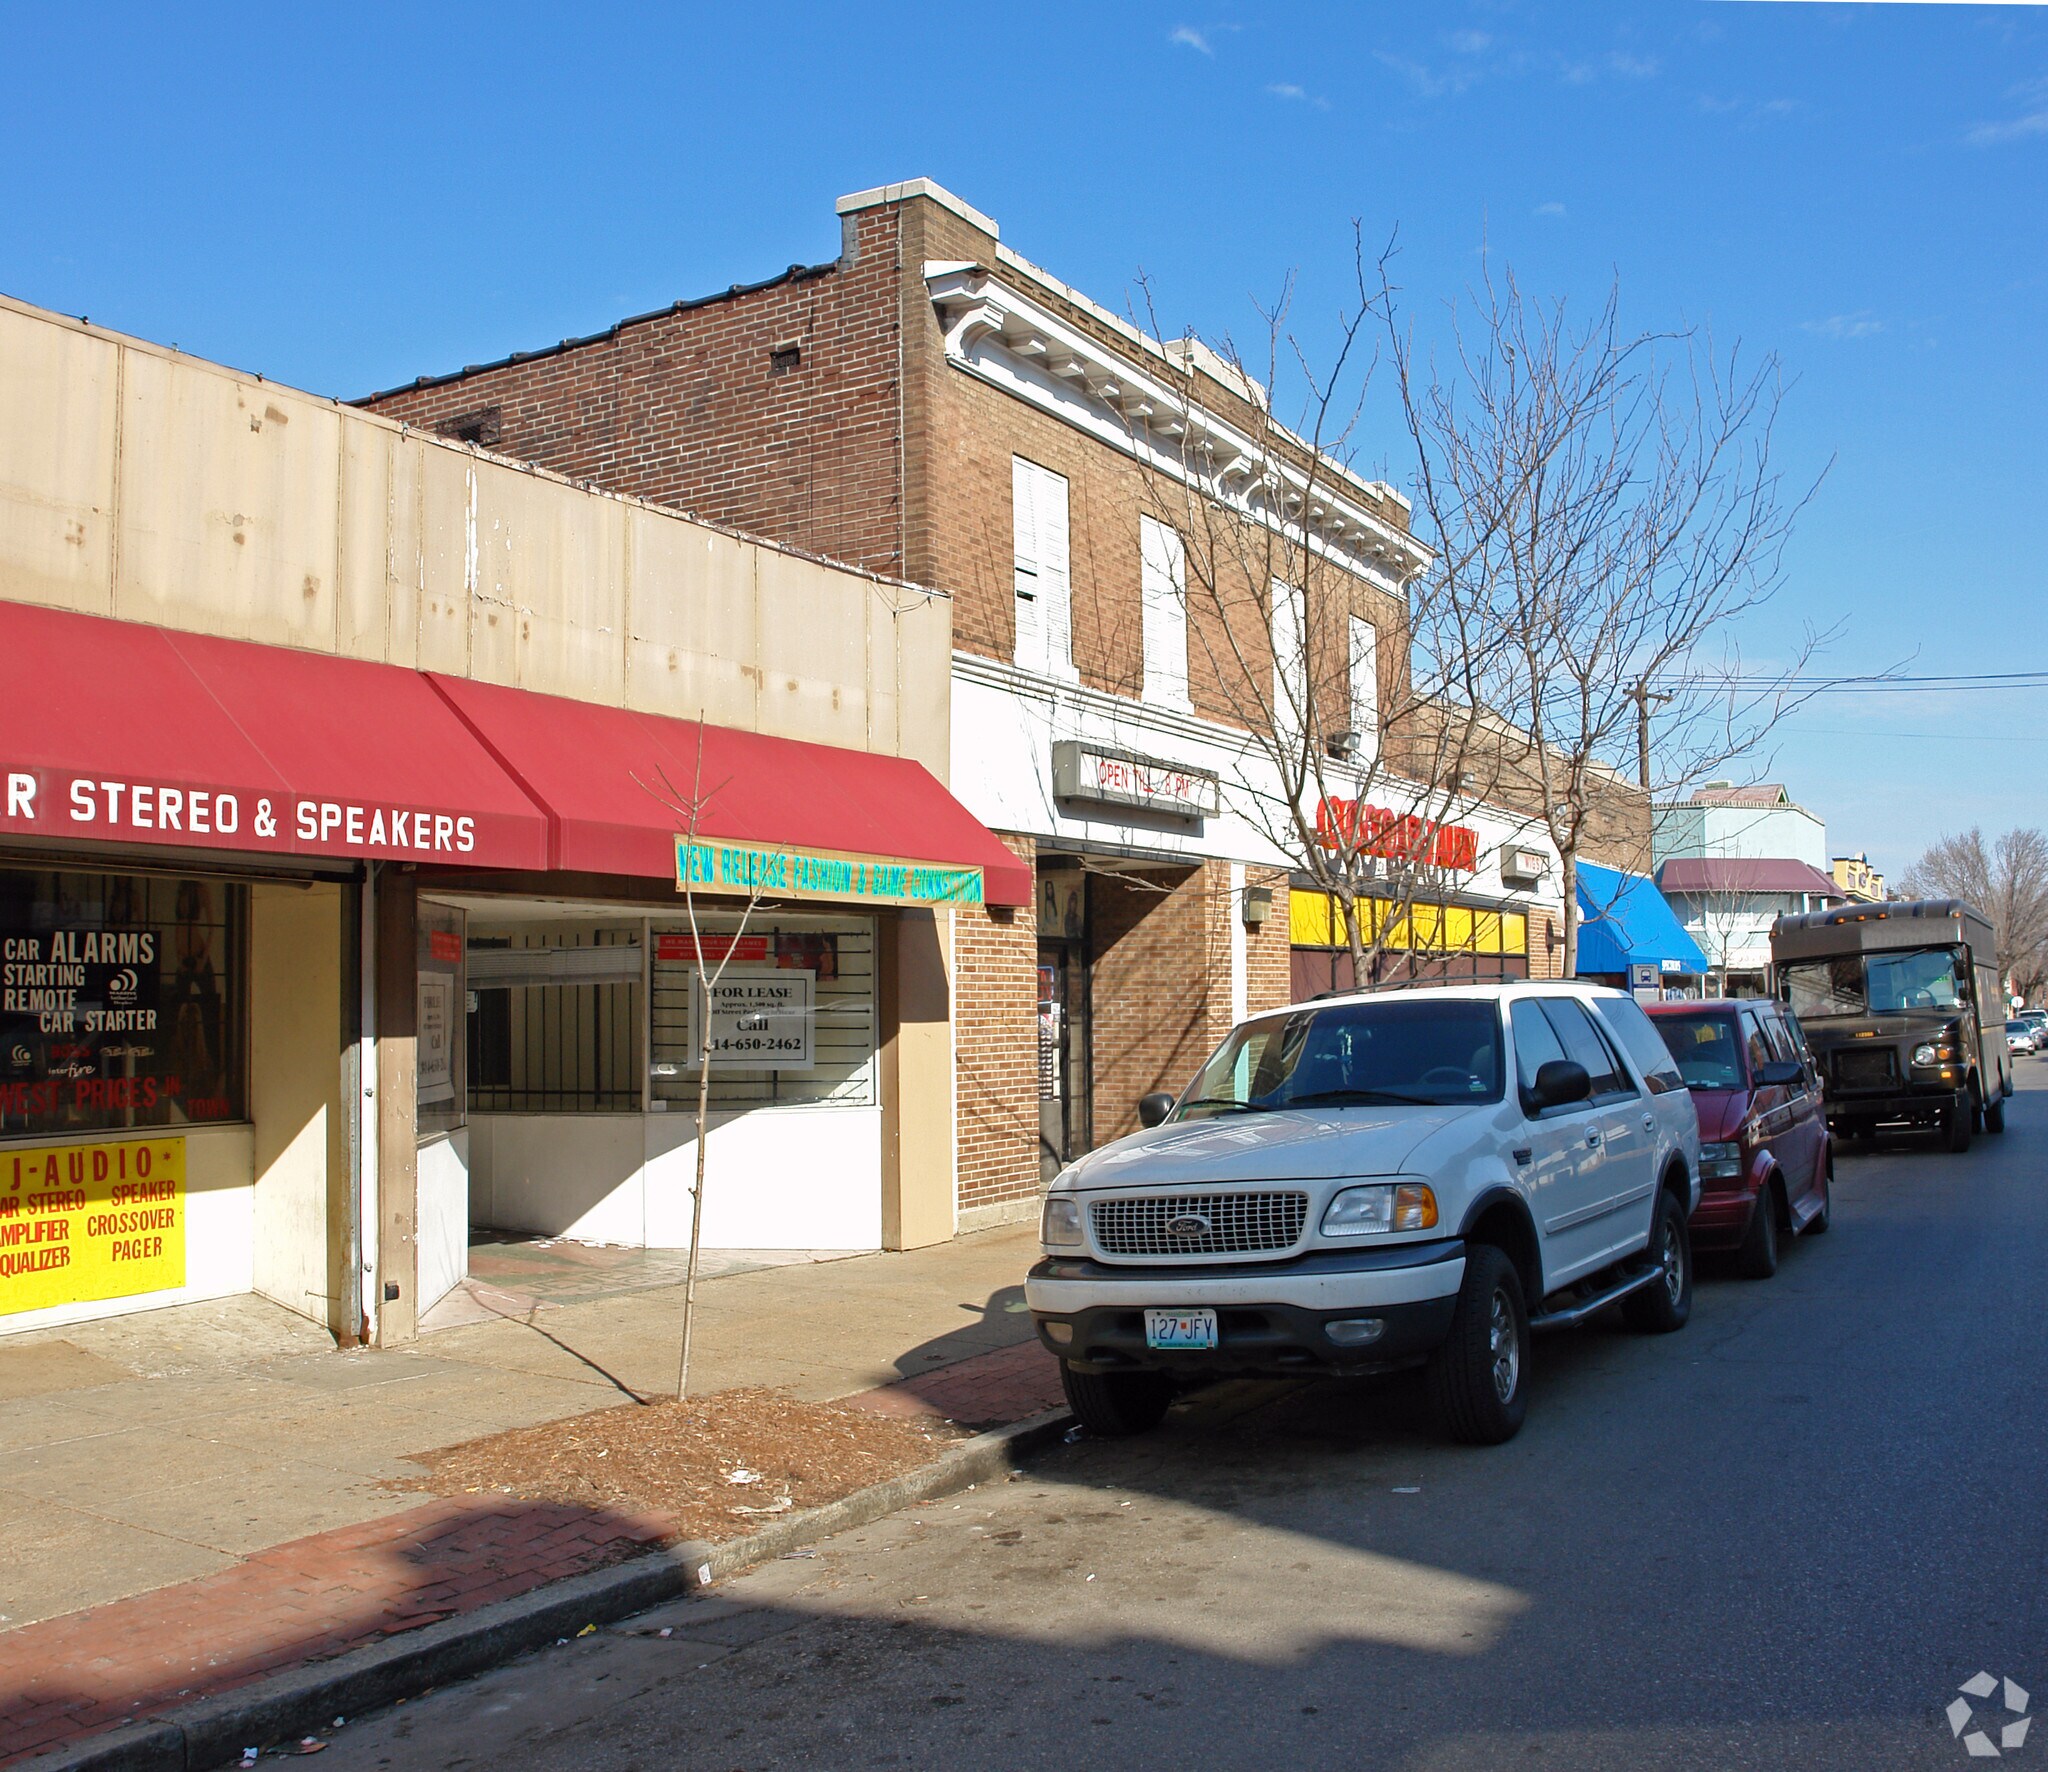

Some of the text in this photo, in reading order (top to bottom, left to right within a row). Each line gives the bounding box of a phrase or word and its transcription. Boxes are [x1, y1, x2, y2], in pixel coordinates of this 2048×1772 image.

[1099, 761, 1128, 788] OPEN
[69, 779, 239, 834] STEREO
[253, 798, 277, 837] &
[296, 801, 475, 852] SPEAKERS
[677, 844, 983, 904] NEW RELEASE FASHION & GAME CONNECTION
[4, 931, 155, 964] CAR ALARMS
[3, 964, 85, 987] STARTING
[4, 989, 78, 1011] REMOTE
[713, 987, 793, 998] FOR LEASE
[40, 1010, 158, 1033] CAR STARTER
[737, 1019, 769, 1032] Call
[713, 1038, 802, 1051] 14-650-2462
[75, 1076, 158, 1112] PRICES
[27, 1188, 86, 1215] STEREO
[111, 1180, 176, 1207] SPEAKER
[0, 1219, 70, 1248] MPLIFIER
[87, 1207, 175, 1237] CROSSOVER
[1176, 1220, 1199, 1232] Ford
[0, 1245, 71, 1278] QUALIZER
[112, 1236, 163, 1262] PAGER
[1151, 1318, 1213, 1340] 127 JFY
